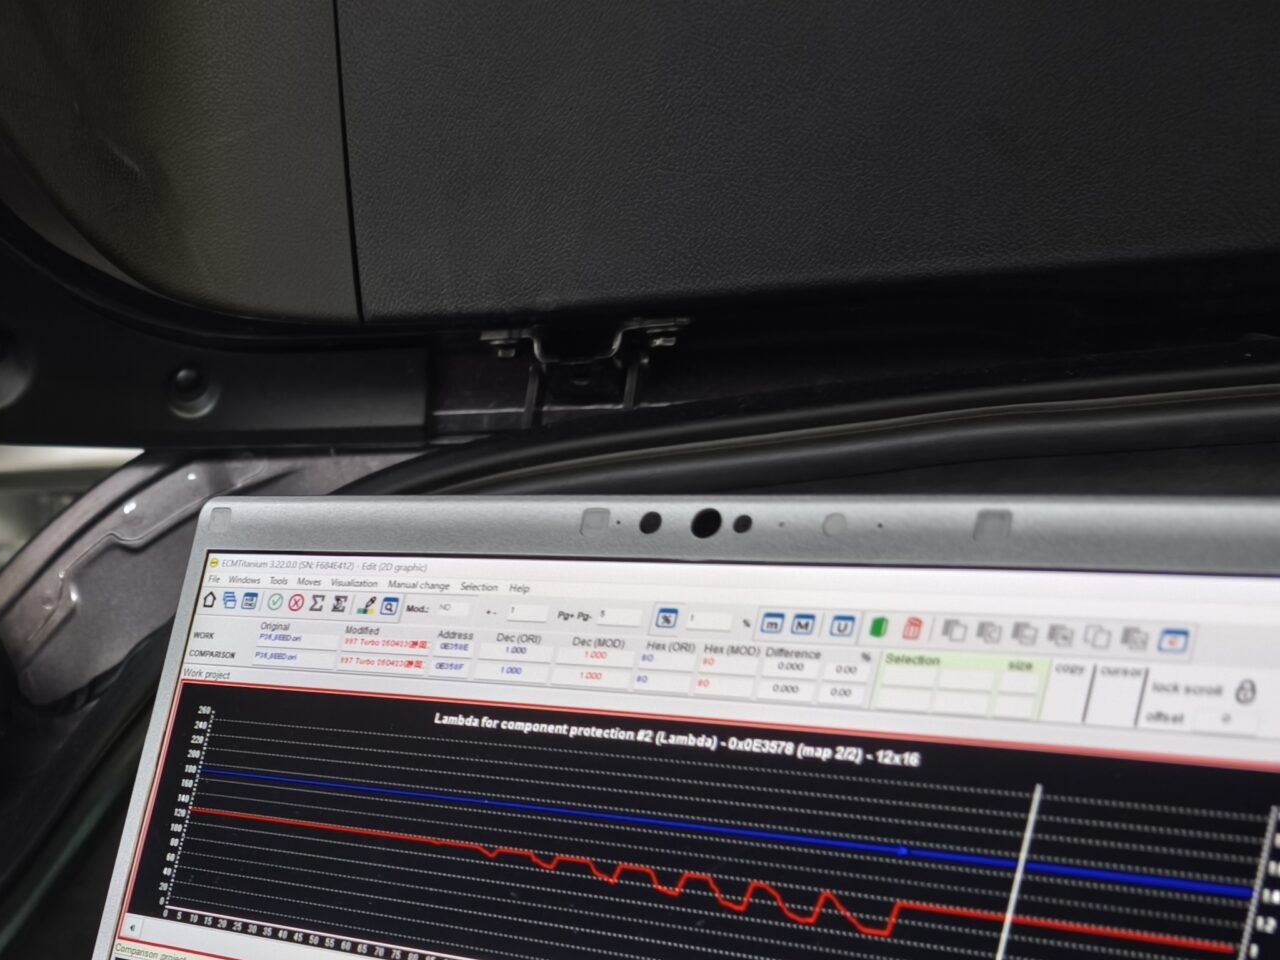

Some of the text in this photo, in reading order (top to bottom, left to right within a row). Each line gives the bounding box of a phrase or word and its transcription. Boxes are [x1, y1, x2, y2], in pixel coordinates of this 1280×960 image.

[222, 560, 268, 569] ECMTitanium
[362, 563, 376, 571] Edit
[394, 564, 427, 573] graphic)
[229, 576, 261, 584] Windows
[271, 577, 288, 585] Tools
[297, 577, 321, 586] Moves
[331, 578, 378, 588] Visualization
[388, 580, 418, 589] Manual
[420, 582, 450, 592] change
[460, 582, 499, 591] Selection
[509, 584, 530, 594] Help
[194, 632, 214, 640] WORK
[260, 622, 541, 645] Original Modified Address Dec (ORI)
[189, 650, 236, 659] COMPARISON
[572, 637, 821, 660] Dec (MOD) Hex (ORI) Hex (MOD) Difference
[886, 653, 1142, 677] Selection size copy cursor
[183, 668, 230, 681] Work project
[1153, 682, 1223, 696] lock scroll
[1145, 711, 1184, 724] offset
[434, 712, 480, 728] Lambda
[481, 716, 499, 729] for
[501, 720, 568, 735] component
[569, 725, 635, 741] protection
[637, 729, 653, 741] #2
[655, 731, 718, 751] (Lambda)
[796, 743, 833, 762] (map
[835, 747, 862, 764] 2/2)
[875, 750, 921, 767] 12x16
[190, 914, 198, 923] 10
[204, 916, 213, 925] 15
[217, 919, 227, 928] 20
[232, 922, 242, 931] 25
[248, 924, 257, 934] 30
[262, 927, 272, 936] 35
[293, 932, 303, 942] 45
[309, 935, 319, 945] 50
[325, 937, 335, 948] 55
[391, 949, 401, 960] 75
[116, 943, 158, 959] Comparison
